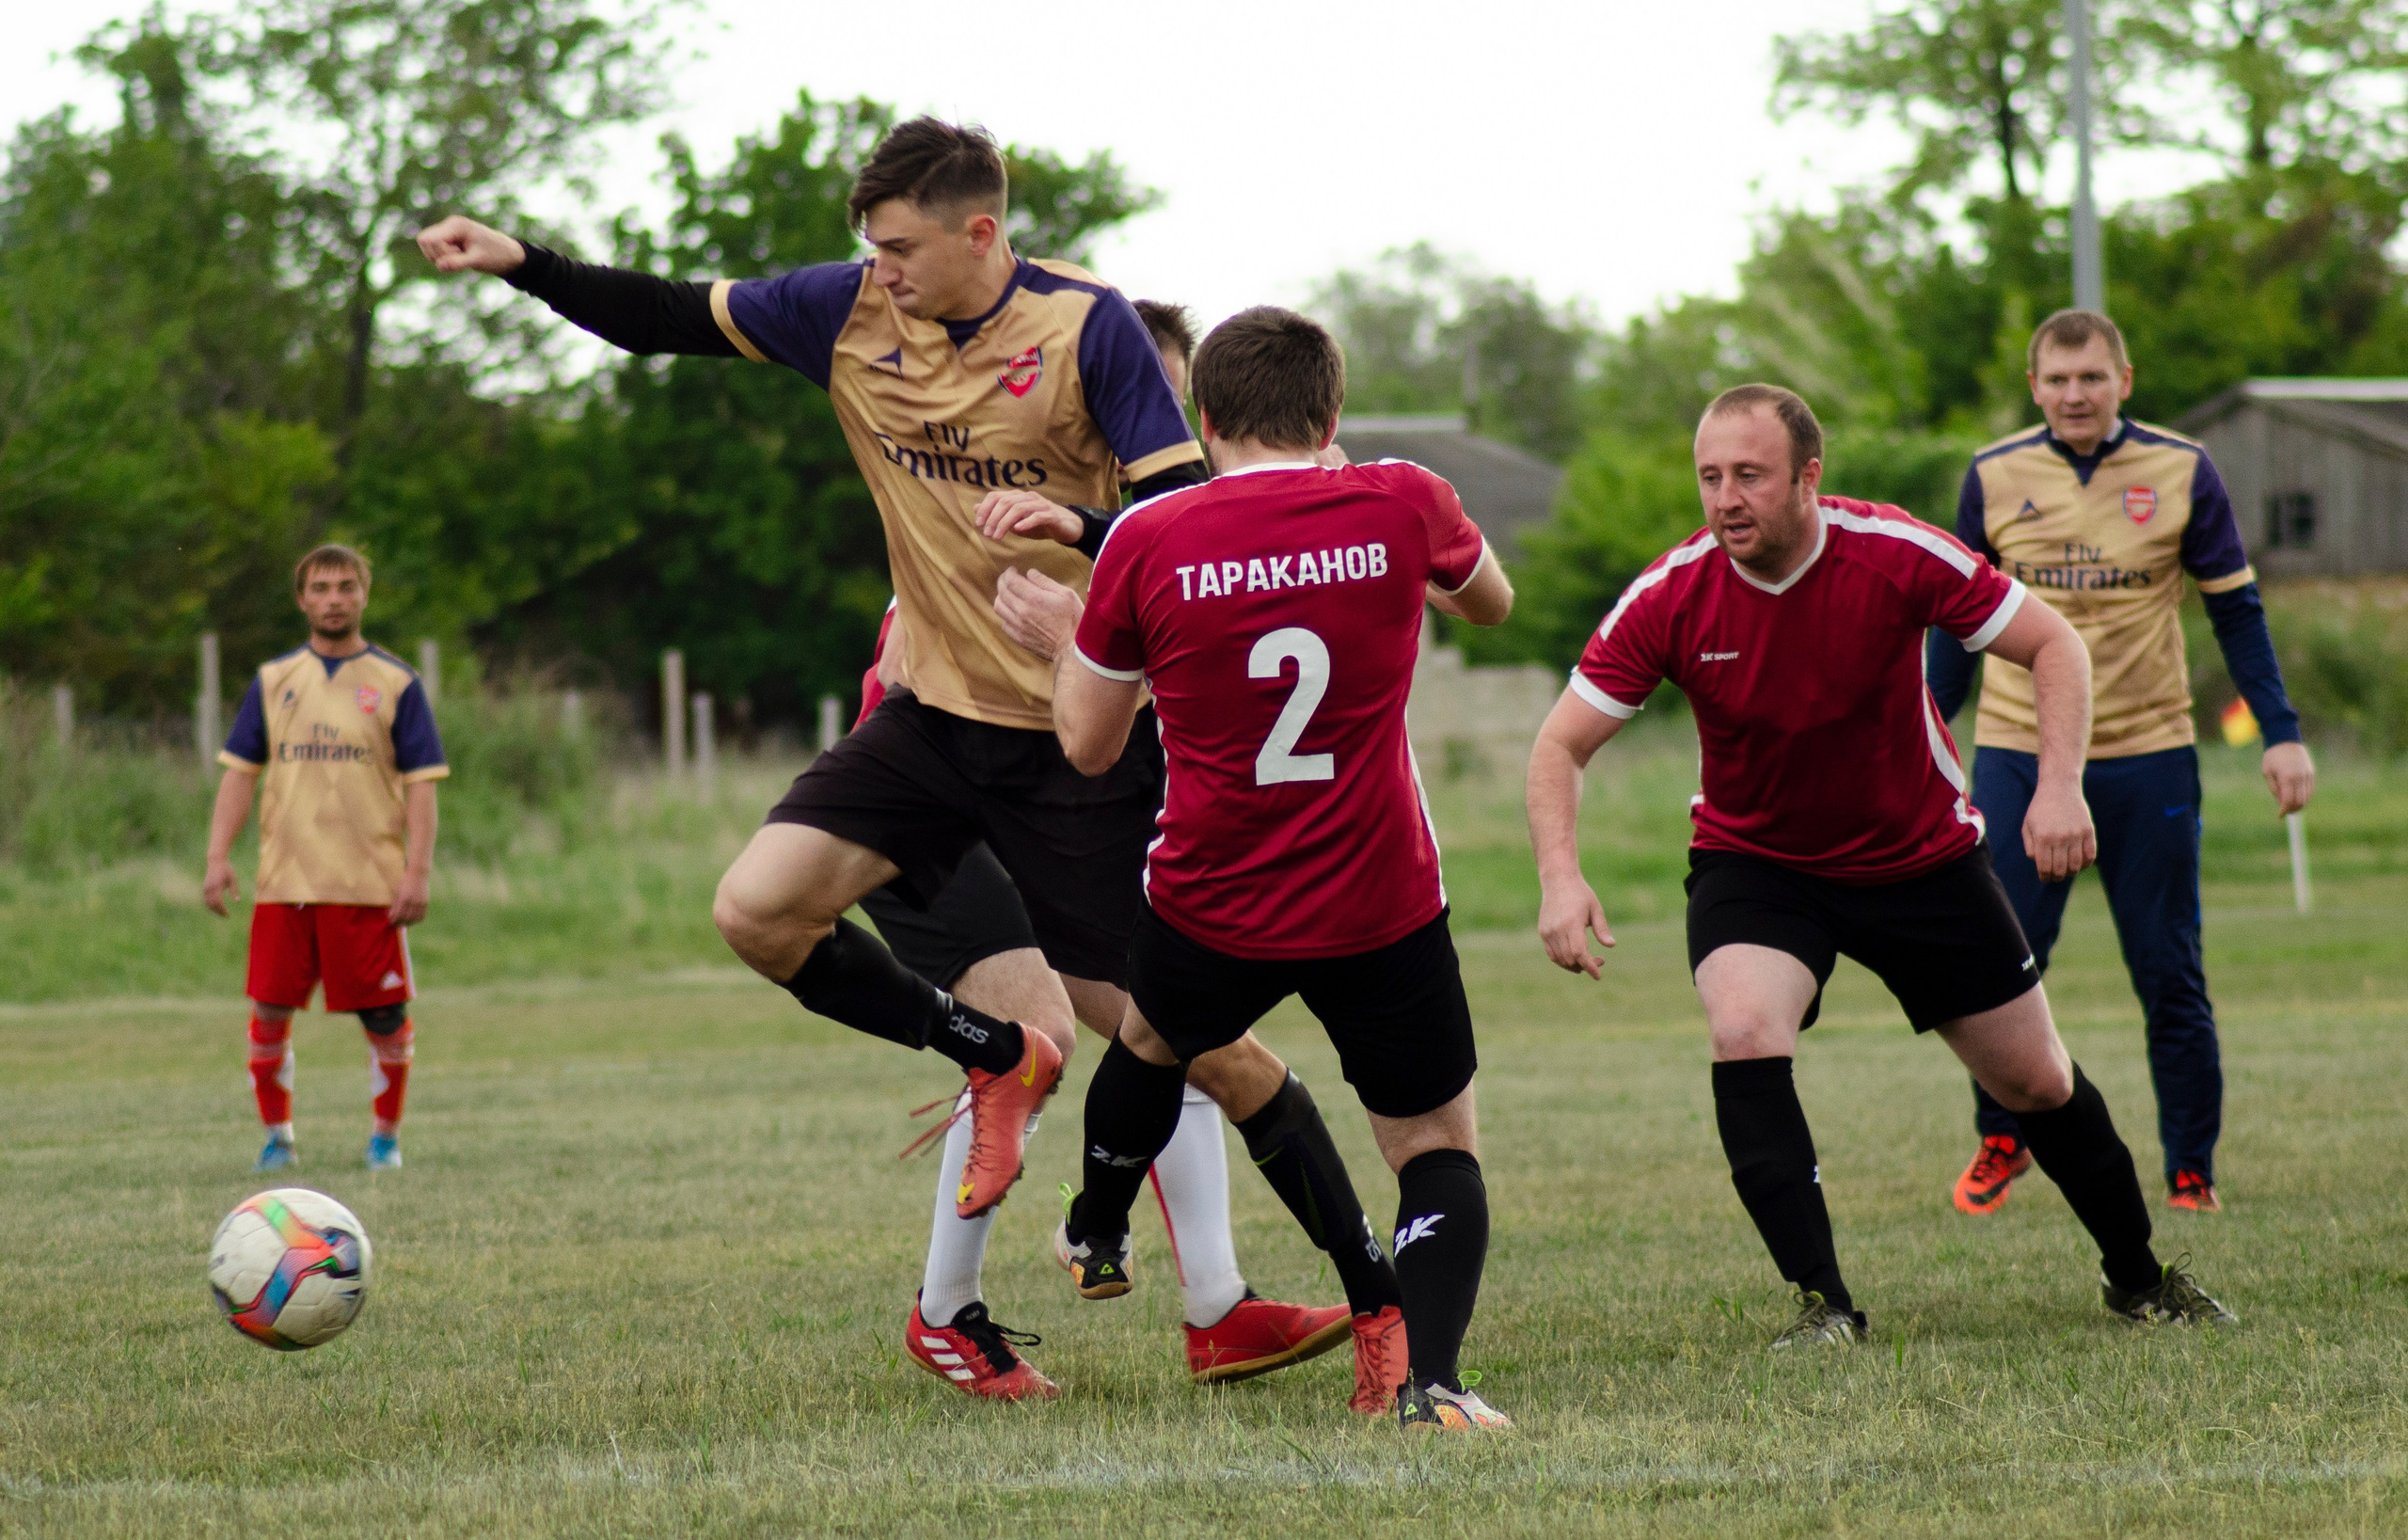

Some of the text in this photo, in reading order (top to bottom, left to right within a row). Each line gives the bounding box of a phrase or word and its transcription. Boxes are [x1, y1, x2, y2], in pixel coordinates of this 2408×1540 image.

[924, 420, 970, 452] Fly
[2065, 543, 2101, 564] Fly
[1176, 543, 1388, 600] ТАРАКАНОВ
[2015, 562, 2152, 590] Emirates
[1714, 651, 1739, 660] SPORT
[1248, 627, 1335, 786] 2
[312, 722, 340, 740] Fly
[278, 739, 374, 766] Emirates
